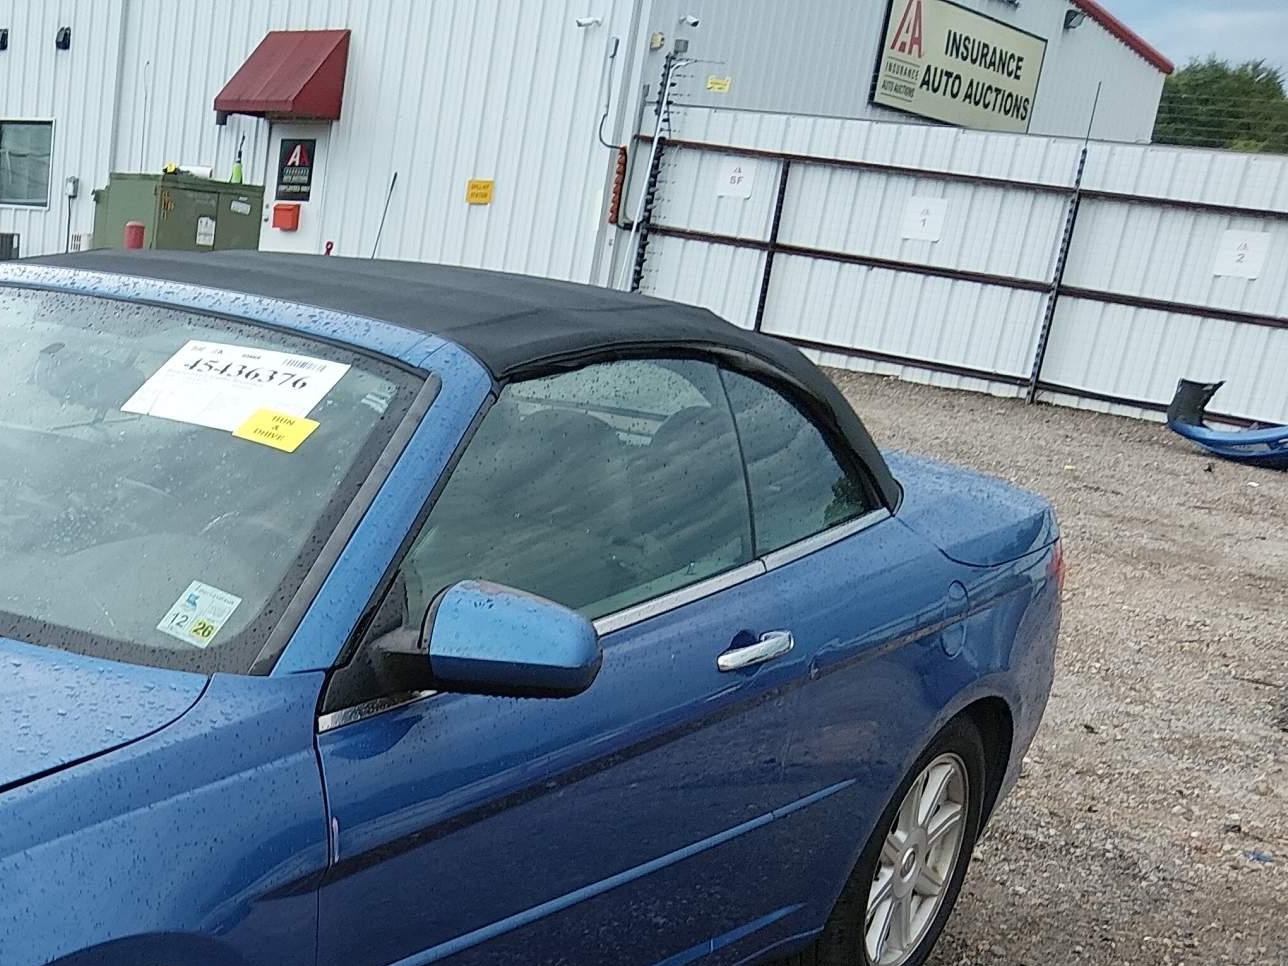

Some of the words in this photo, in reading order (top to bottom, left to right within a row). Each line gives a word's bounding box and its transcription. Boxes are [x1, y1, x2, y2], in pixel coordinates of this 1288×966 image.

[944, 29, 1024, 81] INSURANCE
[885, 61, 920, 81] INSURANCE
[919, 64, 962, 99] AUTO
[962, 78, 1030, 121] AUCTIONS
[1235, 253, 1246, 263] 2
[183, 357, 307, 390] 45436376
[169, 612, 189, 627] 12
[193, 621, 214, 638] 26
